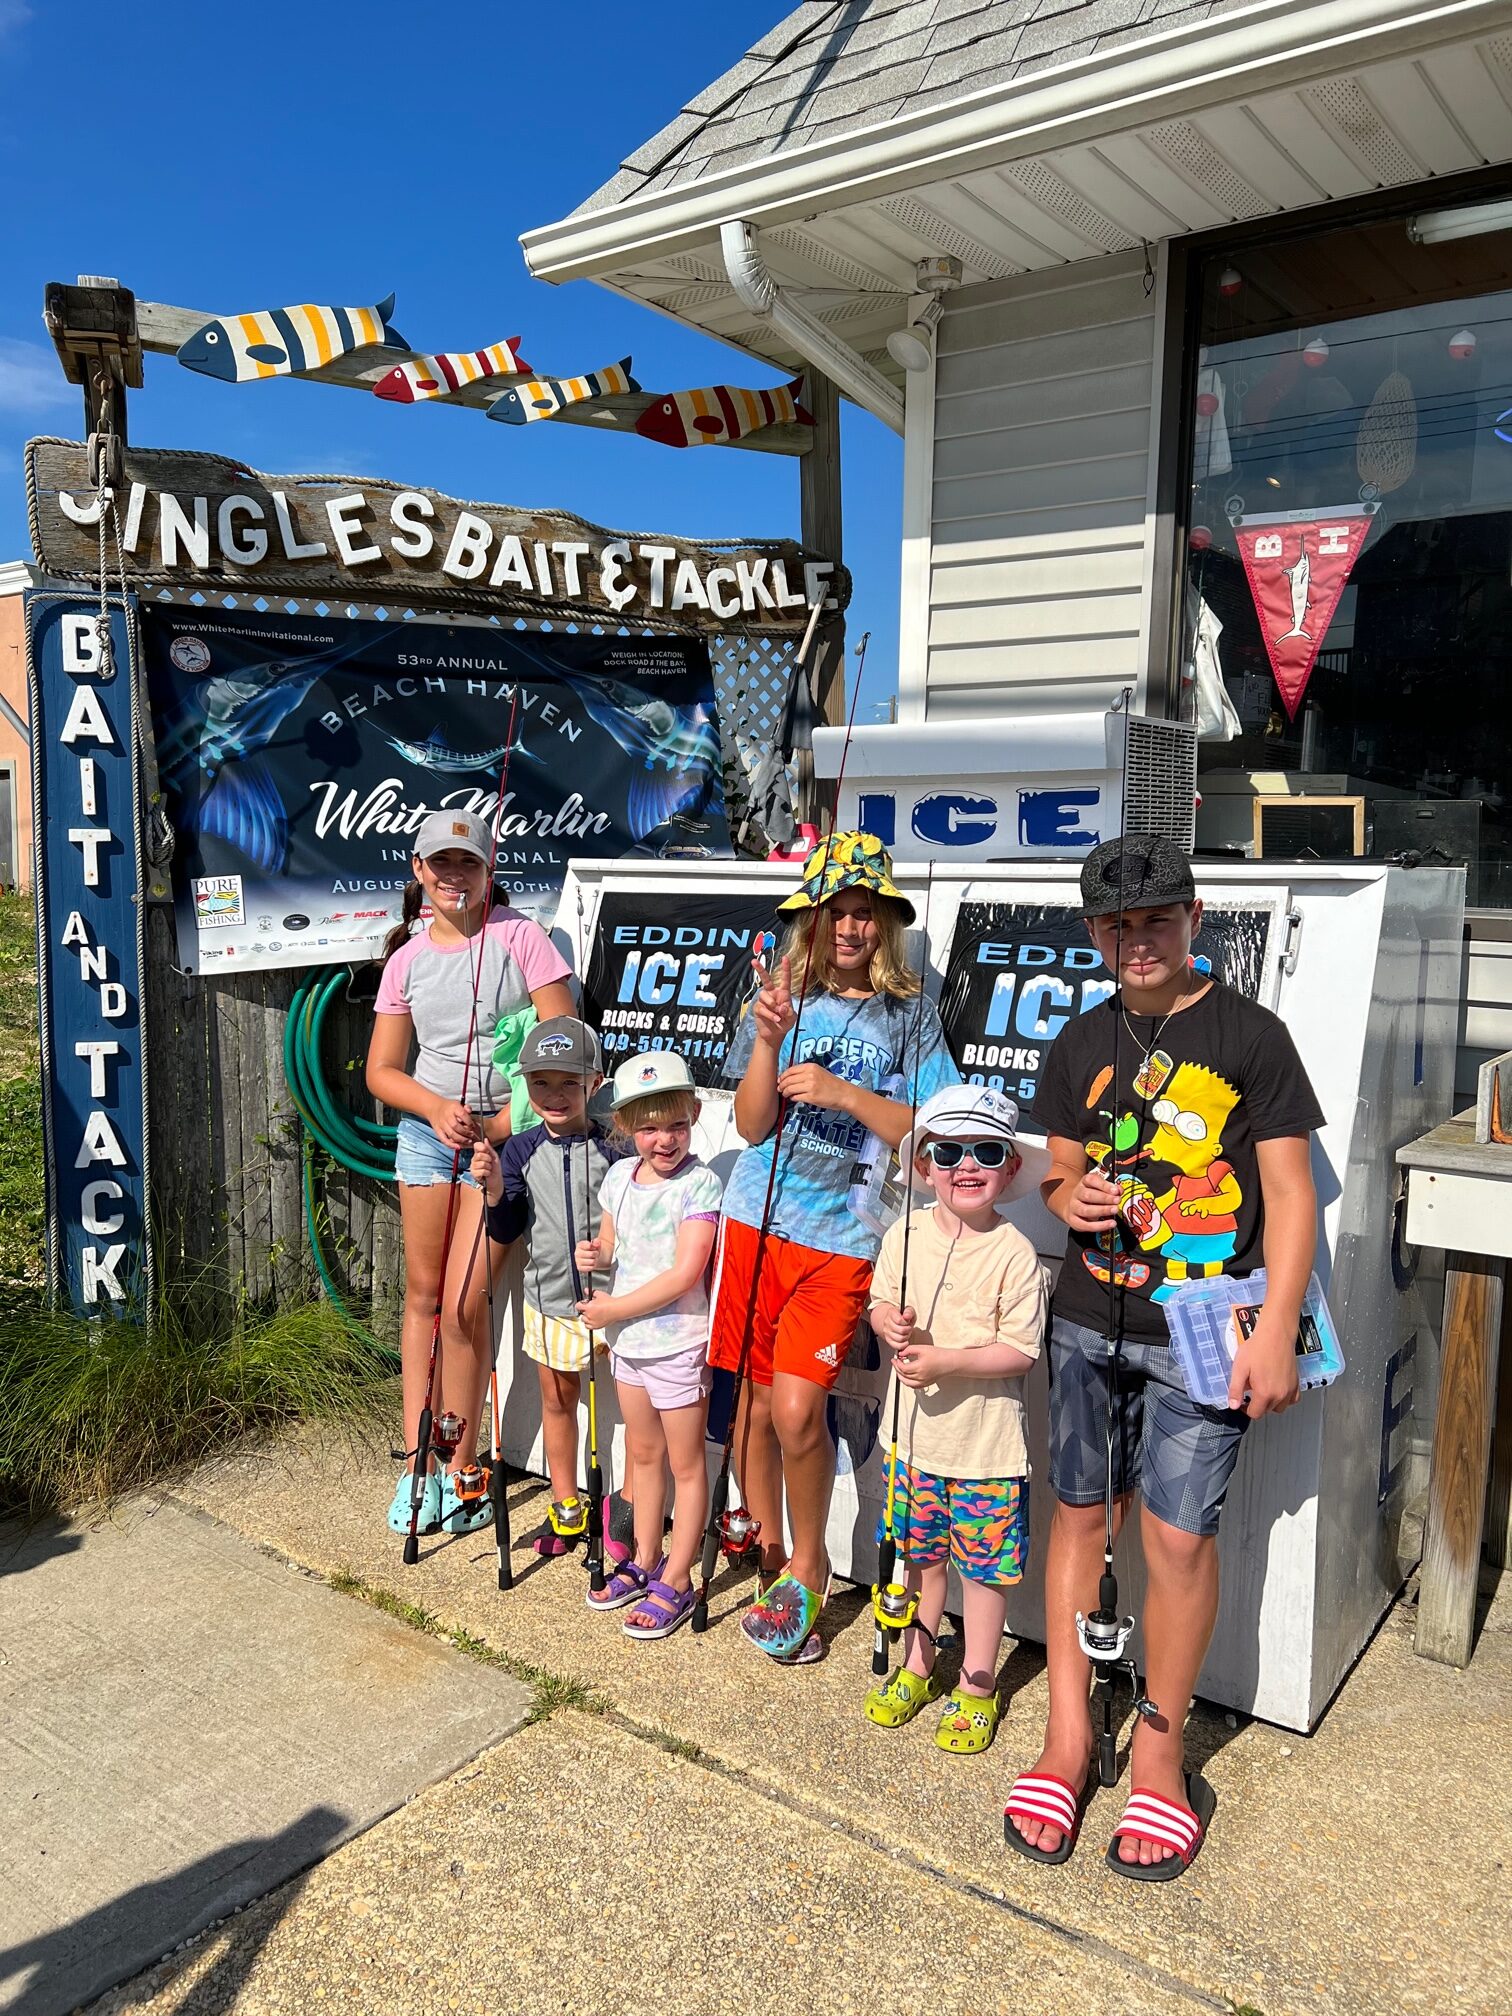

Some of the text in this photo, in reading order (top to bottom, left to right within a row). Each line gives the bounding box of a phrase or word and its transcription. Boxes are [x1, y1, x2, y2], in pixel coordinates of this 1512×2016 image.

[59, 482, 838, 618] JINGLES BAIT & TACKLE
[1254, 534, 1283, 558] B
[1318, 526, 1350, 555] H
[172, 622, 334, 644] www.WhiteMarlinInvitational.com
[397, 654, 508, 671] 53RD ANNUAL
[611, 651, 637, 659] WEIGH
[637, 667, 687, 675] BEACH HAVEN
[319, 676, 583, 743] BEACH HAVEN
[60, 614, 114, 886] BAIT
[309, 777, 612, 843] Whit Marlin
[856, 786, 1100, 847] ICE
[194, 878, 238, 893] PURE
[332, 879, 410, 894] AUGUS
[353, 910, 389, 918] MACK
[613, 926, 750, 948] EDDIN
[61, 911, 126, 1018] AND
[976, 942, 1103, 969] EDD
[616, 950, 726, 1008] ICE
[600, 1009, 725, 1035] BLOCKS & CUBES
[599, 1032, 726, 1059] 09-597-1114
[799, 1035, 893, 1077] ROBERT
[962, 1043, 1041, 1071] BLOCKS
[960, 1071, 1036, 1099] 09-5
[781, 1111, 867, 1152] HUNTE
[800, 1138, 845, 1159] SCHOOL
[74, 1041, 127, 1322] TACK
